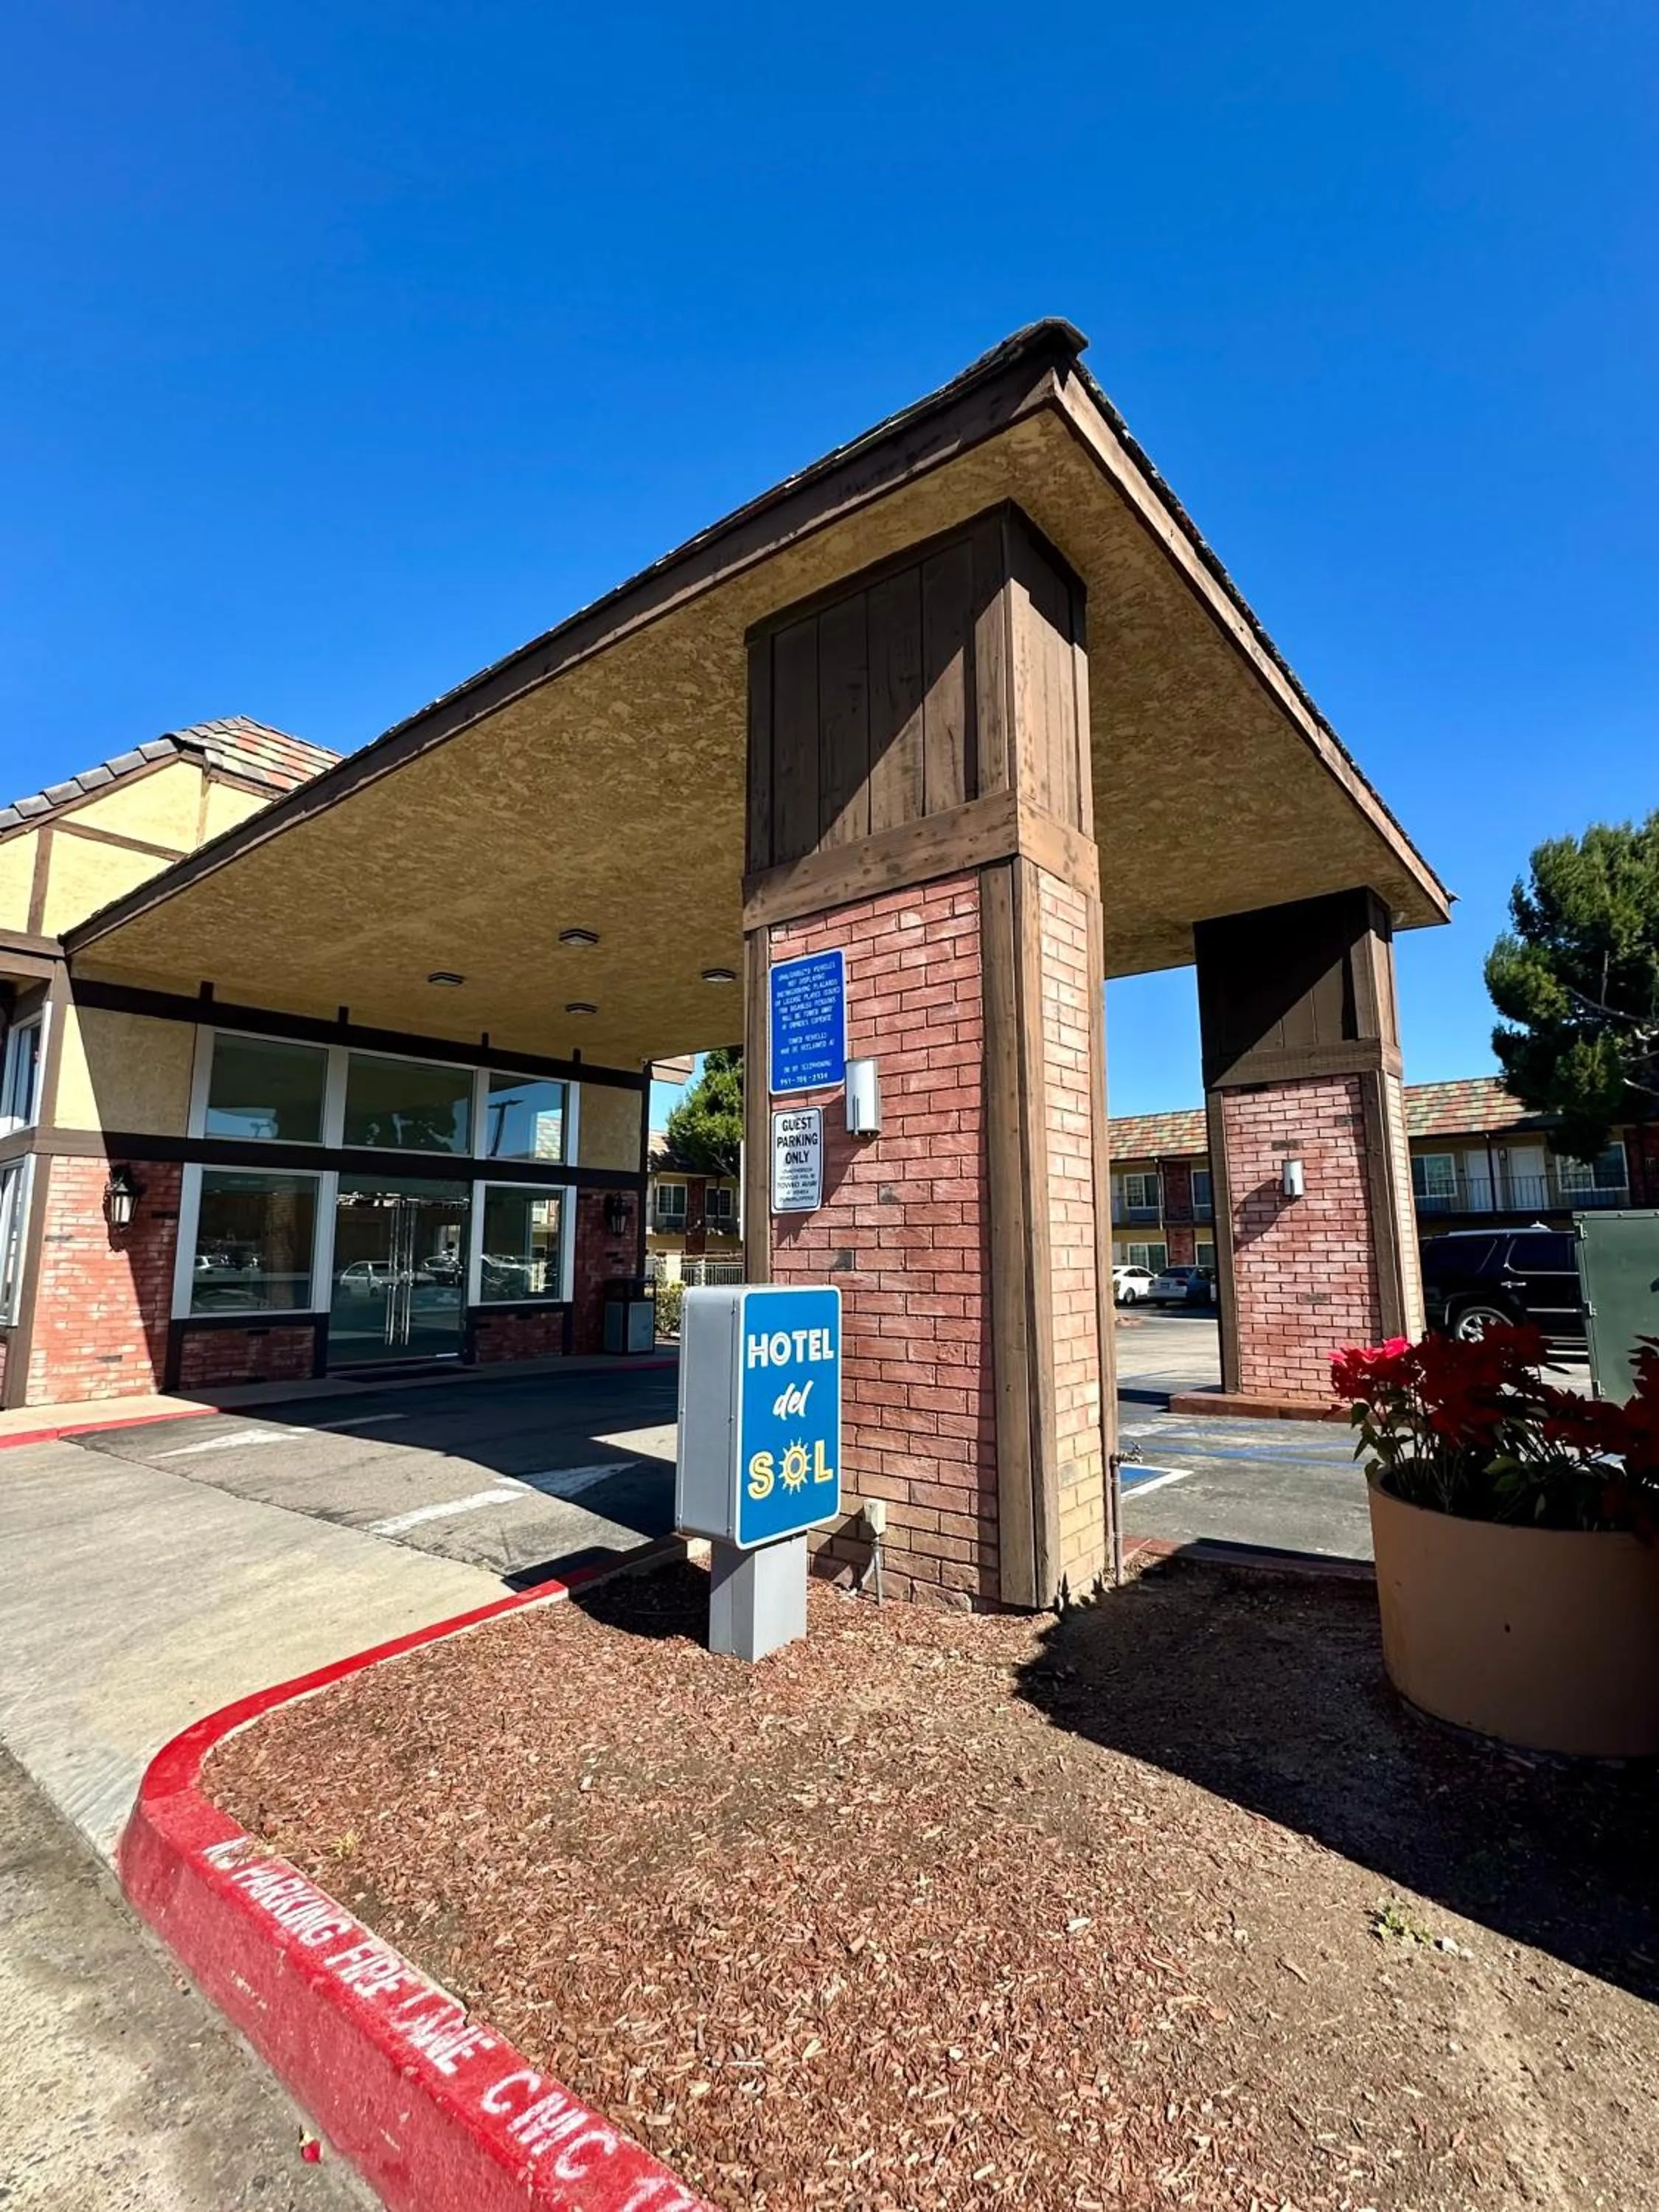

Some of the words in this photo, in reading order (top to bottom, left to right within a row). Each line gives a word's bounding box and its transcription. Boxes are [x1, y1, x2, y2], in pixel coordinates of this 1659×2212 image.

[776, 1132, 818, 1149] PARKING
[782, 1116, 812, 1132] GUEST
[785, 1150, 810, 1164] ONLY
[747, 1328, 835, 1368] HOTEL
[773, 1380, 814, 1421] del
[747, 1437, 834, 1500] SOL
[231, 1861, 354, 1948] PARKING
[323, 1938, 423, 1998] FIRE
[389, 1988, 497, 2076] LANE
[481, 2067, 618, 2180] CMC
